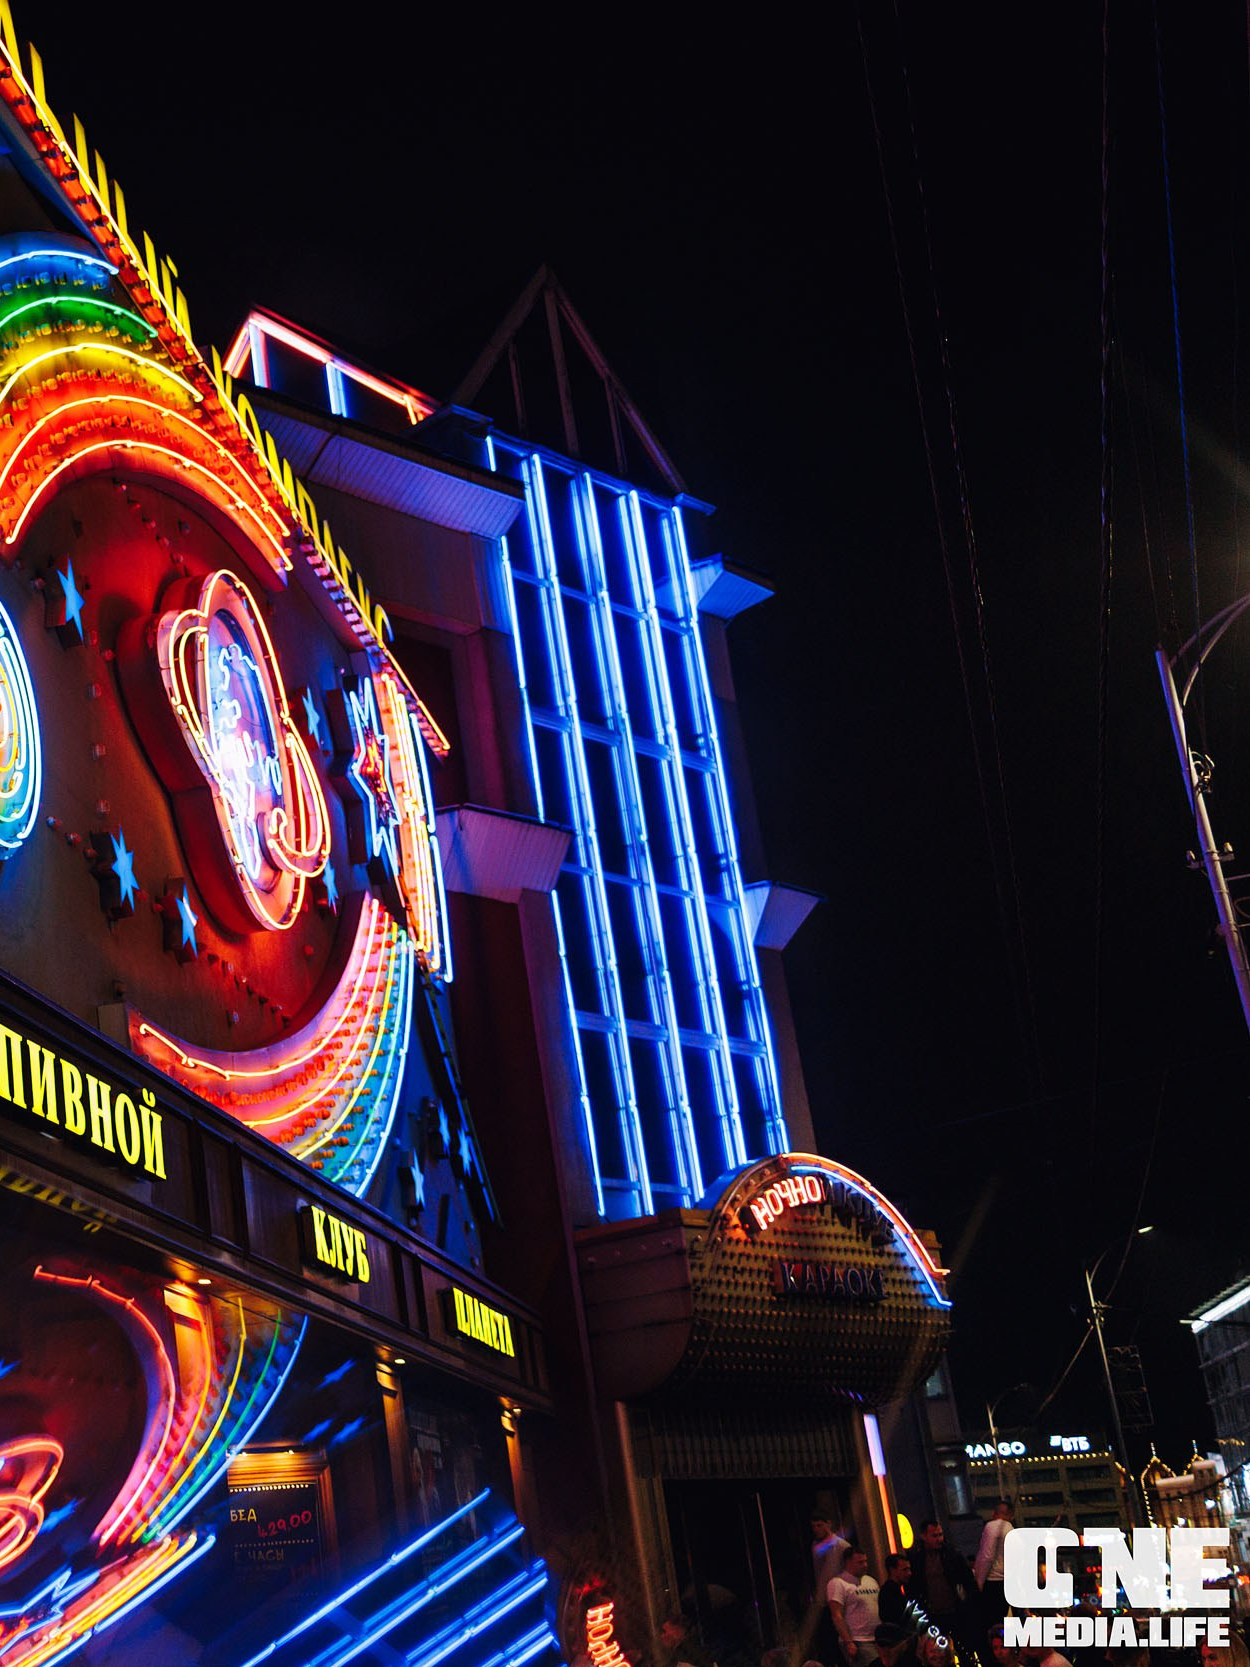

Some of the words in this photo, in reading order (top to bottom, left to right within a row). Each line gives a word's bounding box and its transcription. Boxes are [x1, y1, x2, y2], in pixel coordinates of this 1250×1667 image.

[311, 1205, 371, 1284] КЛУБ
[453, 1287, 515, 1358] ПЛАНЕТА
[1061, 1436, 1091, 1452] ВТБ
